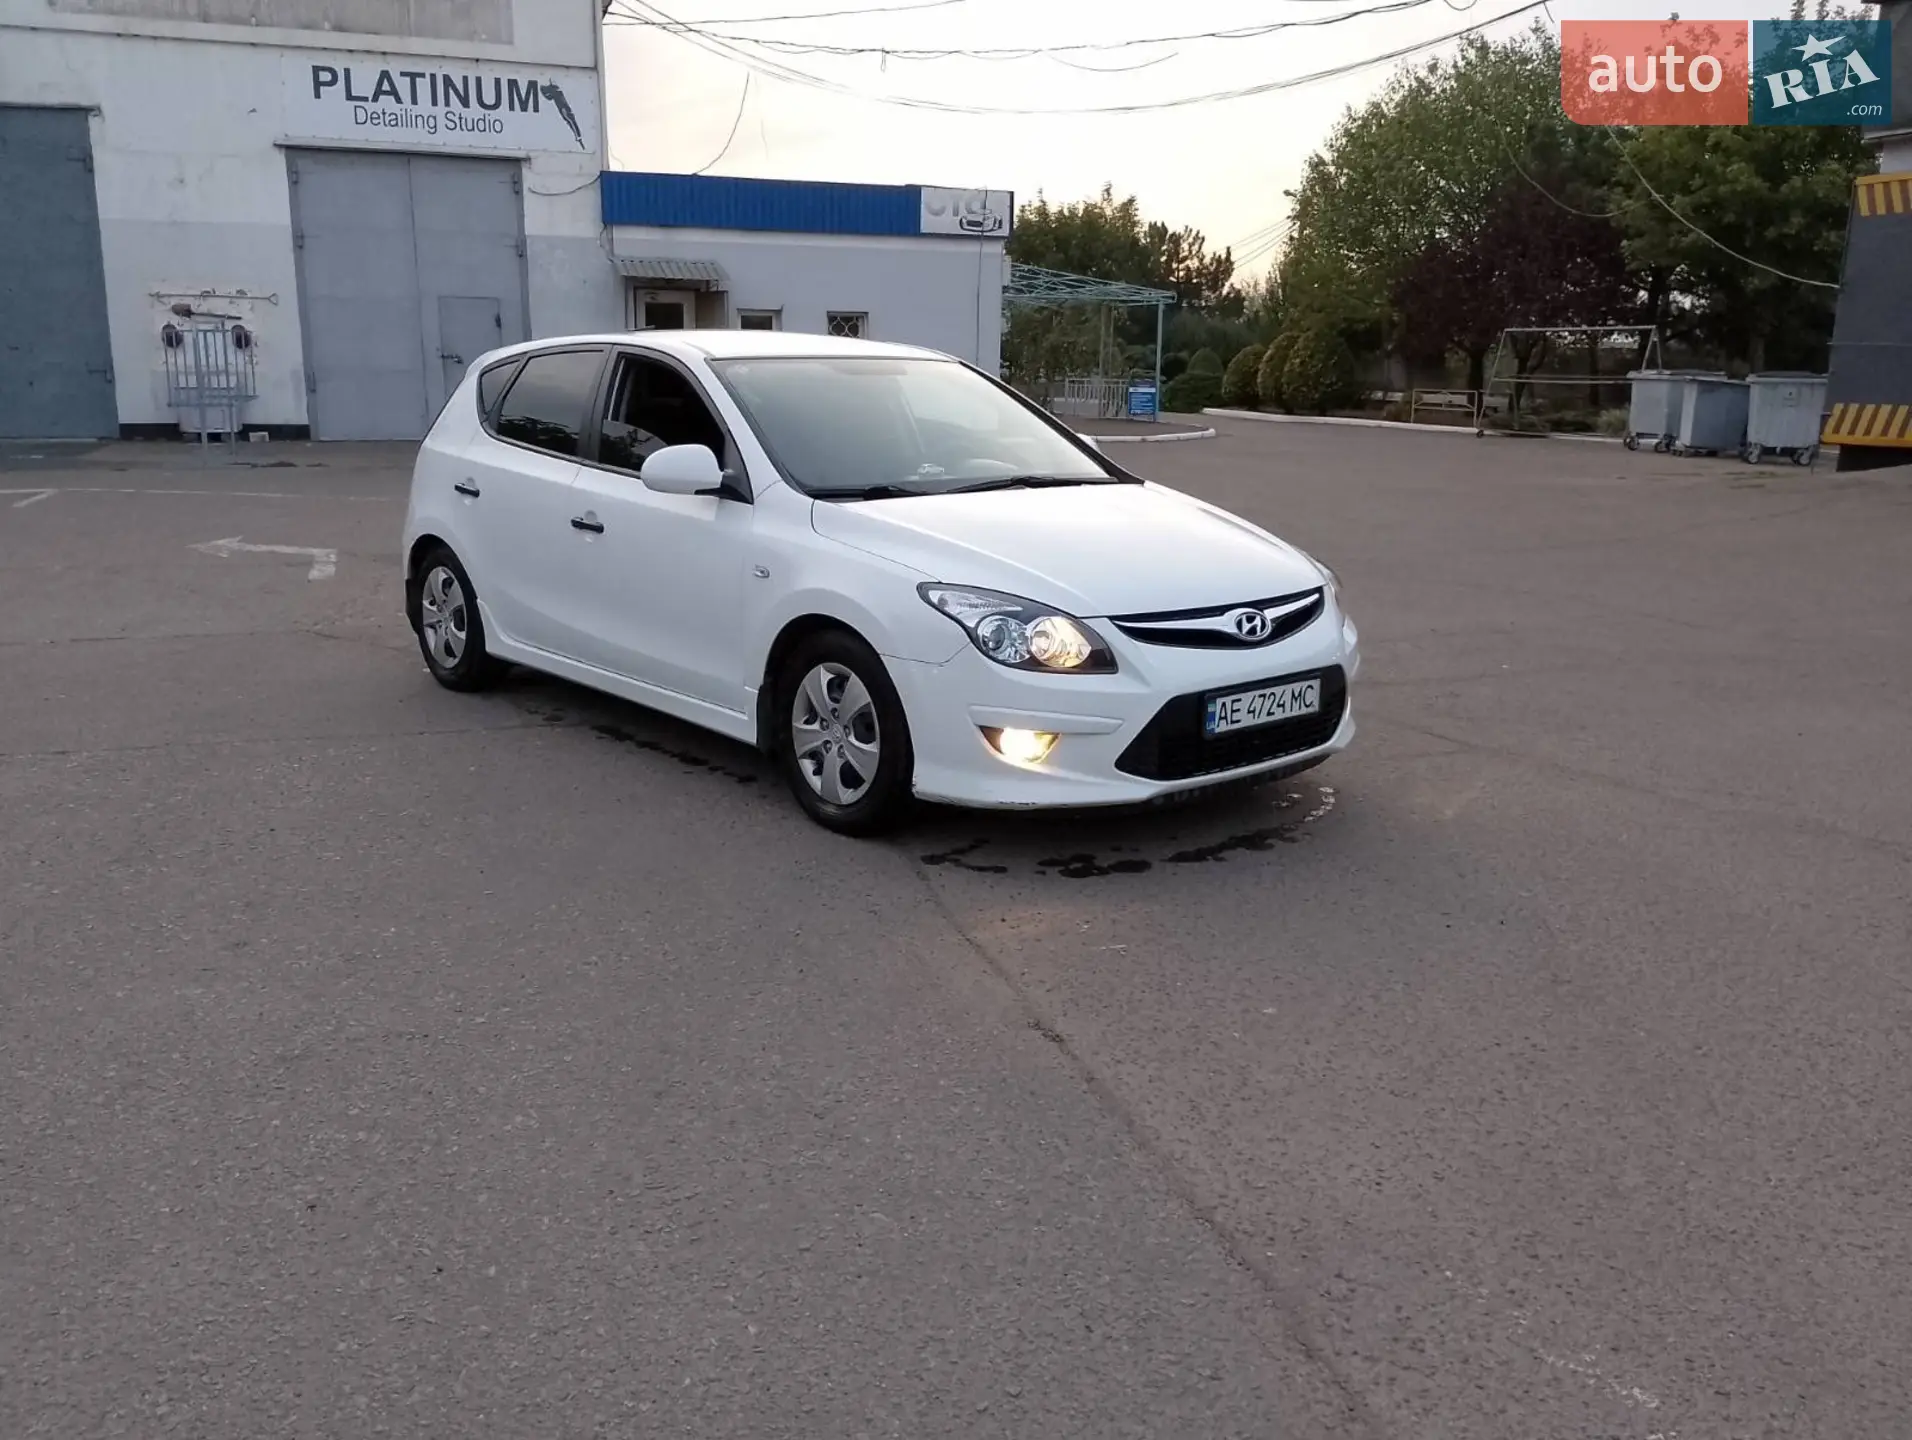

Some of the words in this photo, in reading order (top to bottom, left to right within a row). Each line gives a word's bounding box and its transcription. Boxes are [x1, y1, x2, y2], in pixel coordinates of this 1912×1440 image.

[311, 65, 540, 114] PLATINUM
[353, 105, 438, 134] Detailing
[444, 111, 504, 134] Studio
[1216, 698, 1243, 728] AE
[1247, 689, 1287, 720] 4724
[1290, 684, 1315, 712] MC
